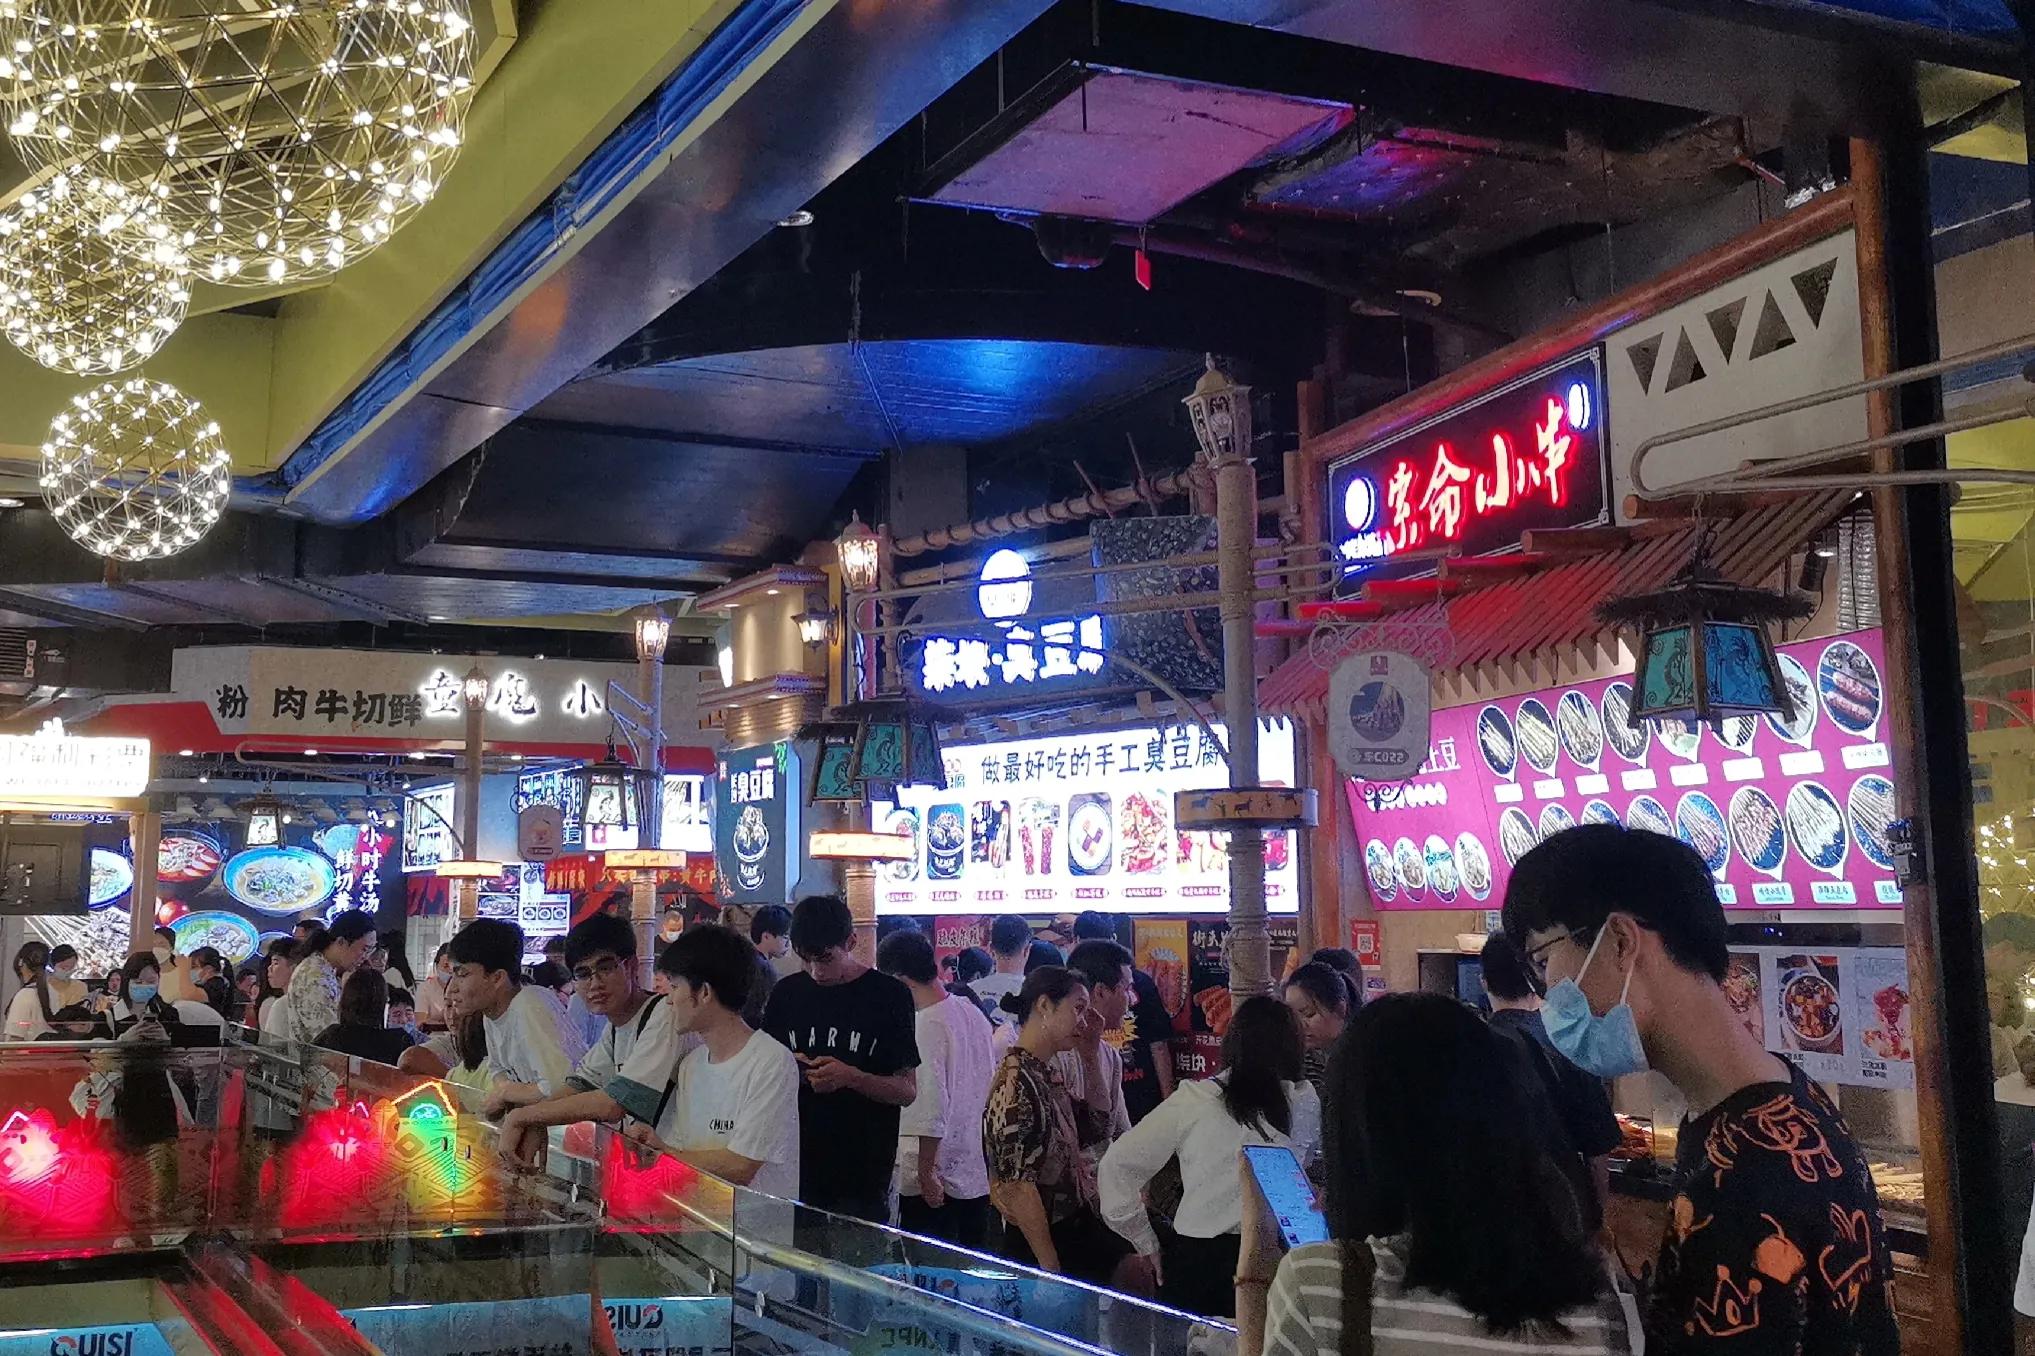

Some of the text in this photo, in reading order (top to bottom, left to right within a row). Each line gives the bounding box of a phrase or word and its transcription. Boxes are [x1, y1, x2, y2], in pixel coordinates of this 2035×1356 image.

[981, 725, 1220, 784] 做最好吃的手工臭豆腐
